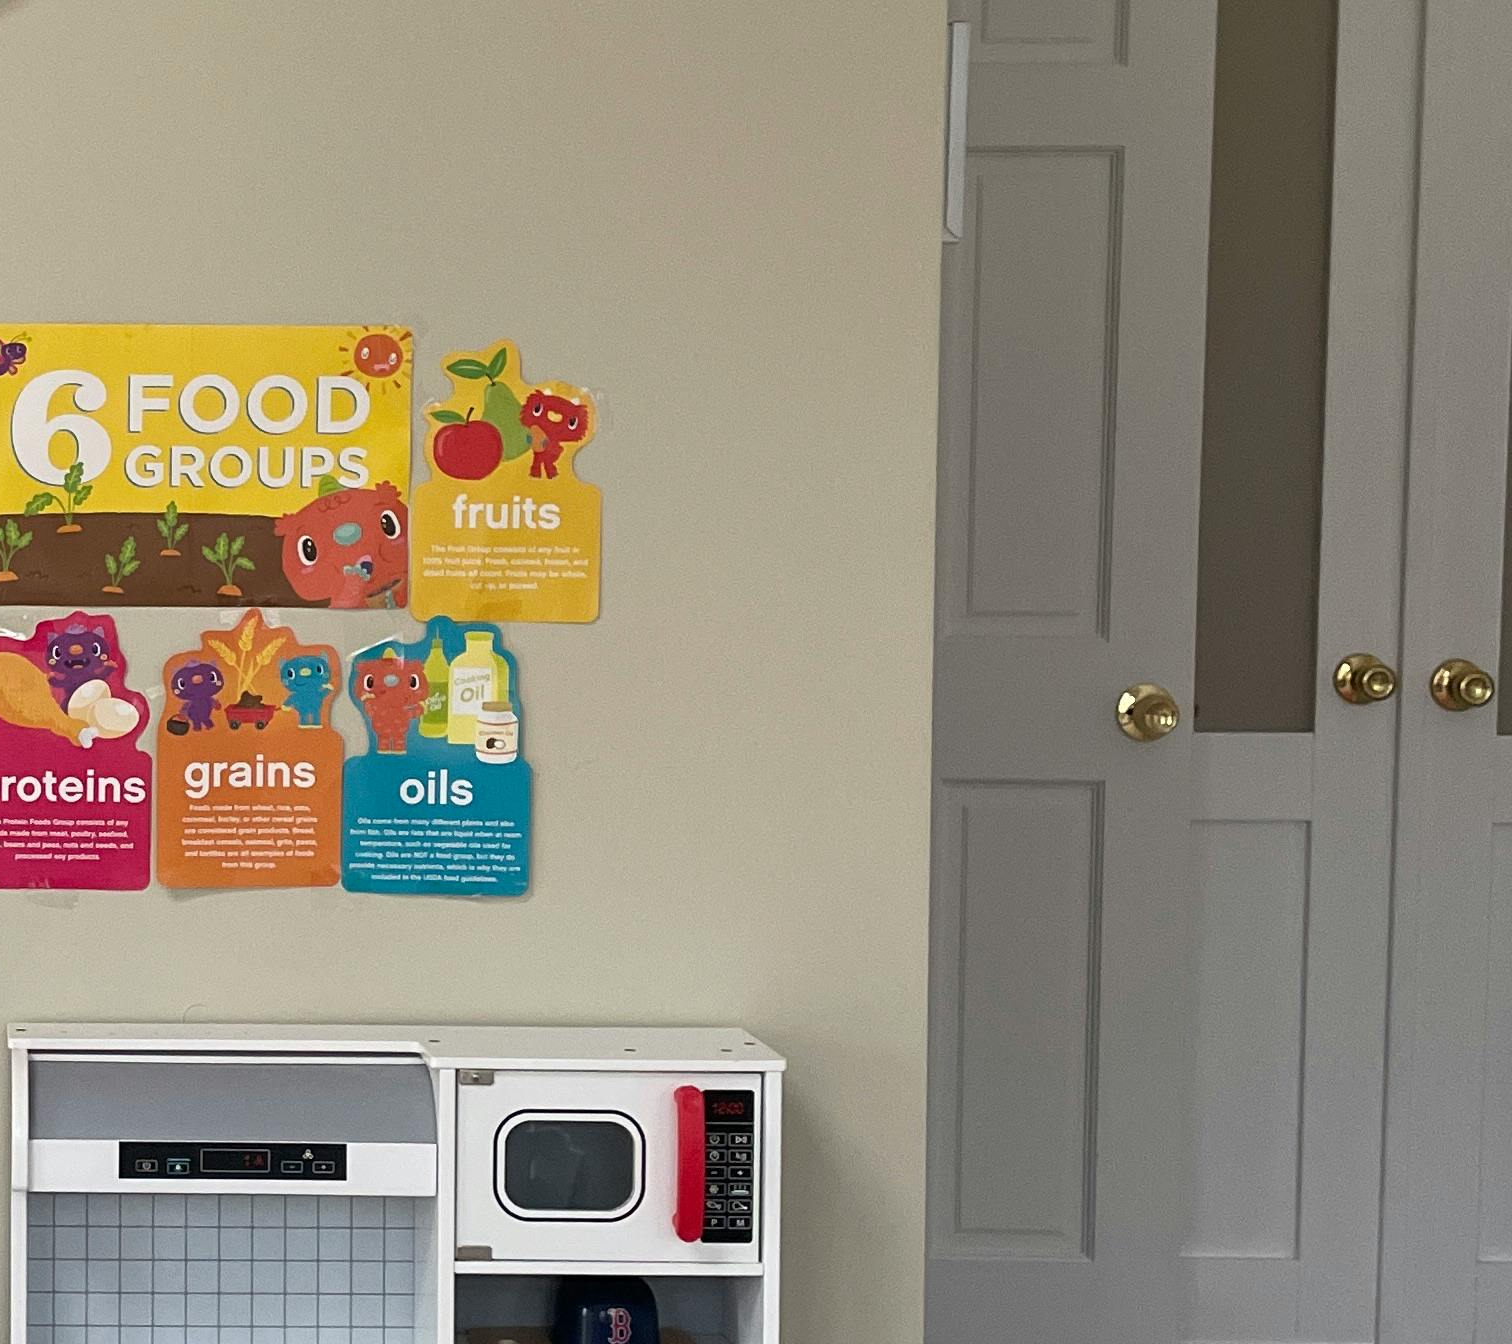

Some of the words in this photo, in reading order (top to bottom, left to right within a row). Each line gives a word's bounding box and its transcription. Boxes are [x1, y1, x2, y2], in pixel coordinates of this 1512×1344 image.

[11, 369, 112, 488] 6
[127, 373, 371, 435] FOOD
[124, 445, 370, 490] GROUPS
[452, 493, 561, 530] fruits
[460, 684, 485, 703] Oil
[184, 754, 316, 799] grains
[399, 769, 474, 806] oils
[607, 1307, 632, 1344] B
